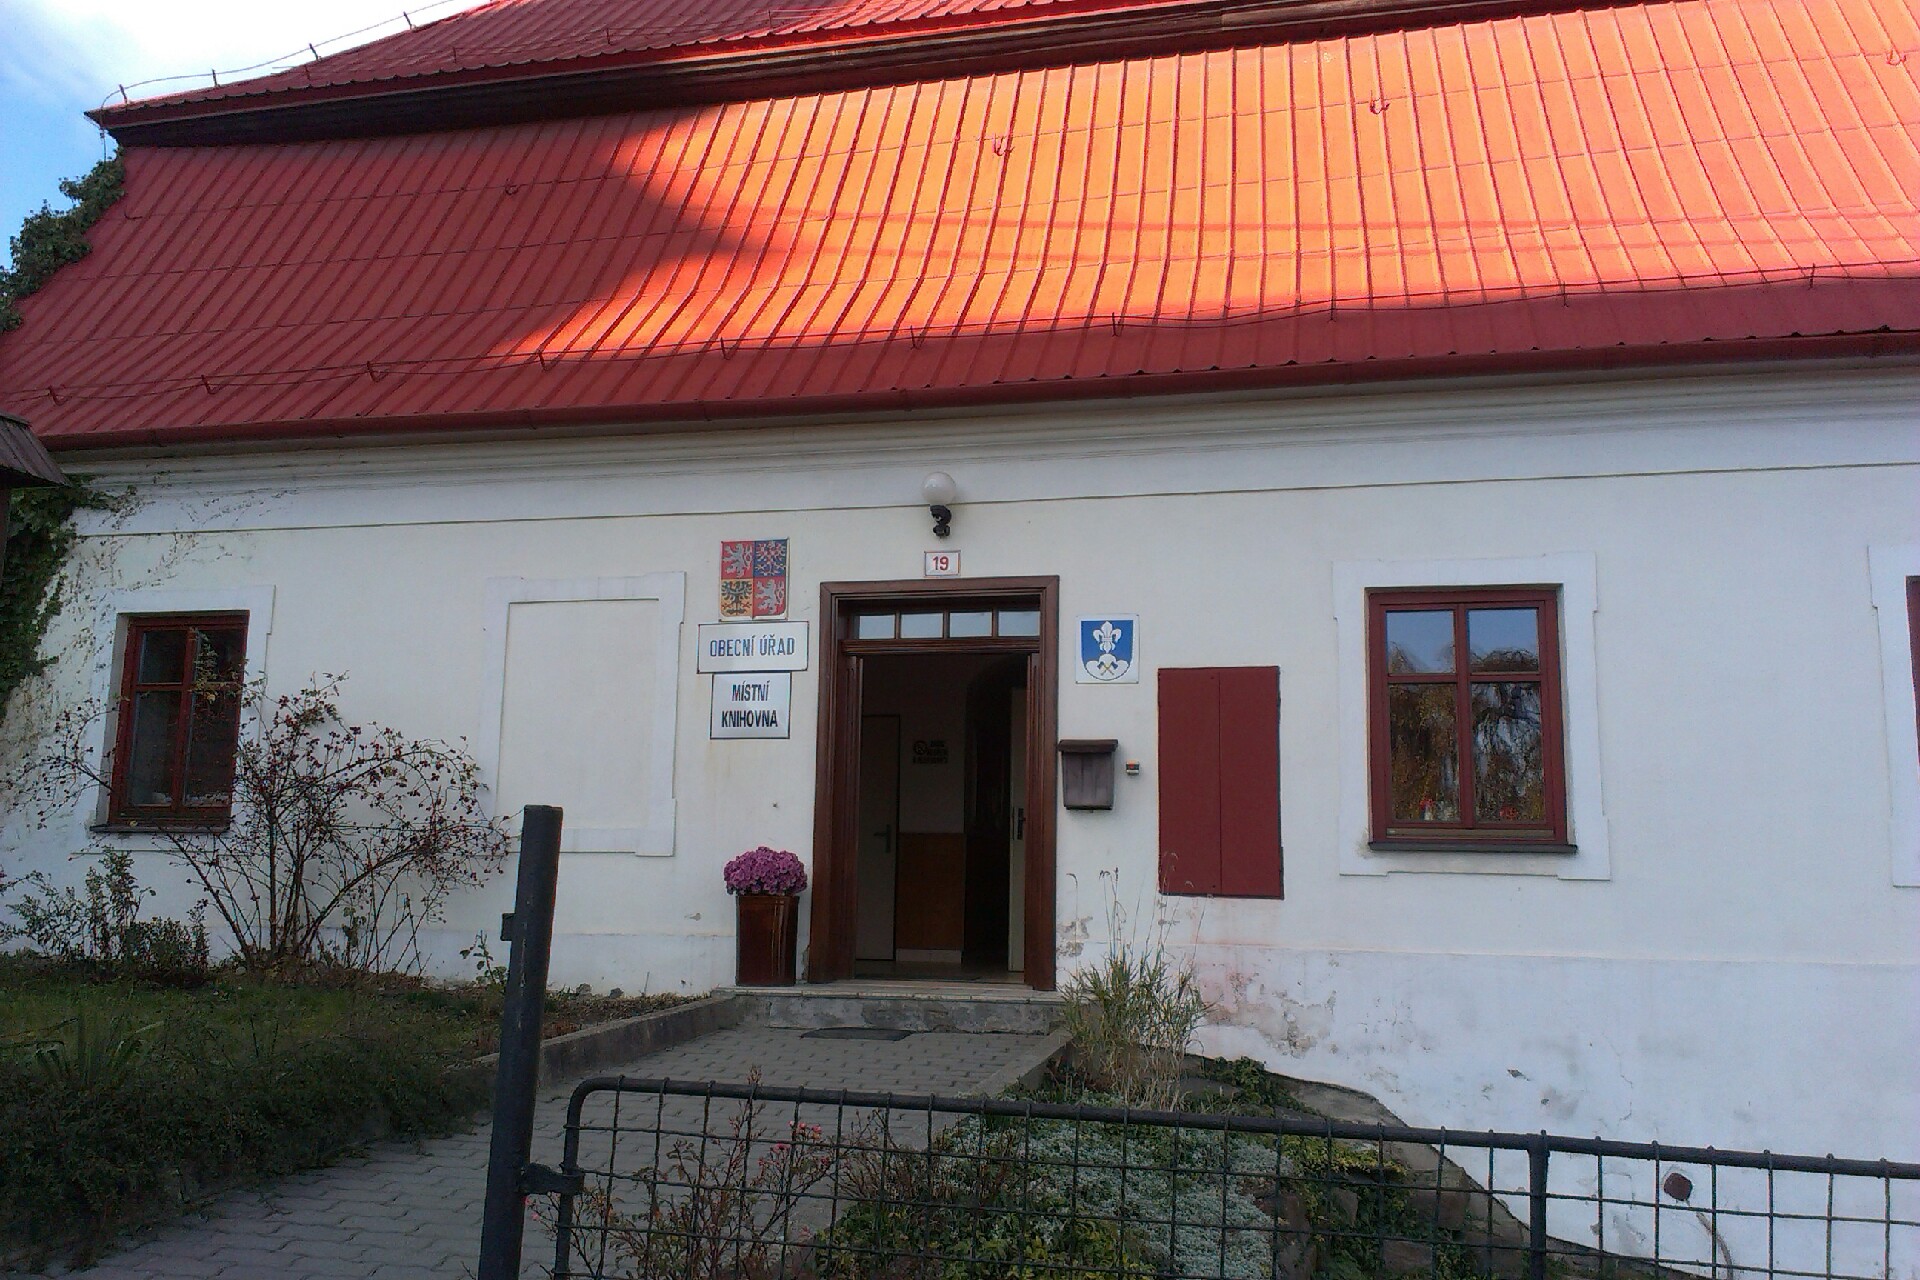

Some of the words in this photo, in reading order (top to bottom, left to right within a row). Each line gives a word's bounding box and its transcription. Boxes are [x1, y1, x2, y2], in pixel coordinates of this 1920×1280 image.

[932, 555, 949, 571] 19
[710, 635, 755, 657] OBECNÍ
[759, 634, 795, 656] ÚŘAD
[731, 680, 770, 701] MÍSTNÍ
[721, 709, 778, 728] KNIHOVNA
